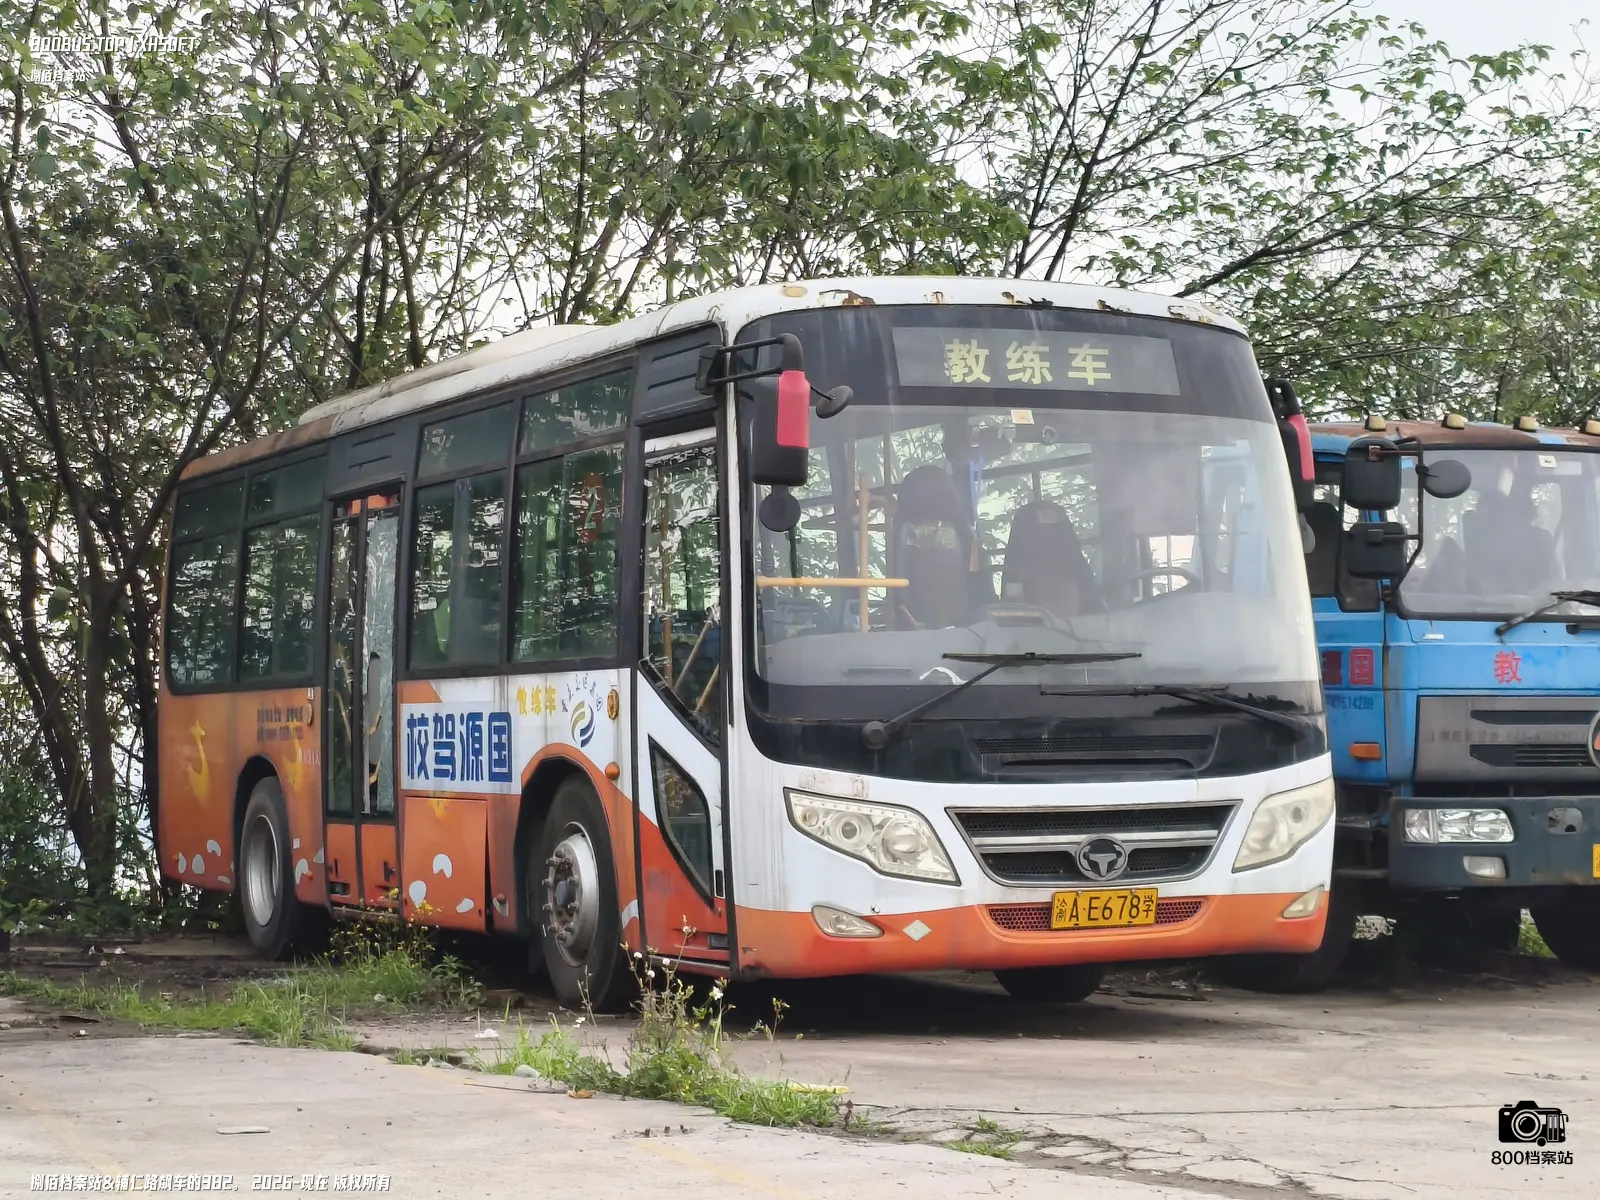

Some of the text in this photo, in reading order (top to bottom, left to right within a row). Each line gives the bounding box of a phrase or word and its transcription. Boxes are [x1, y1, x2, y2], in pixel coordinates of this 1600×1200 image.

[943, 338, 1112, 386] 教练车
[1493, 650, 1523, 684] 教
